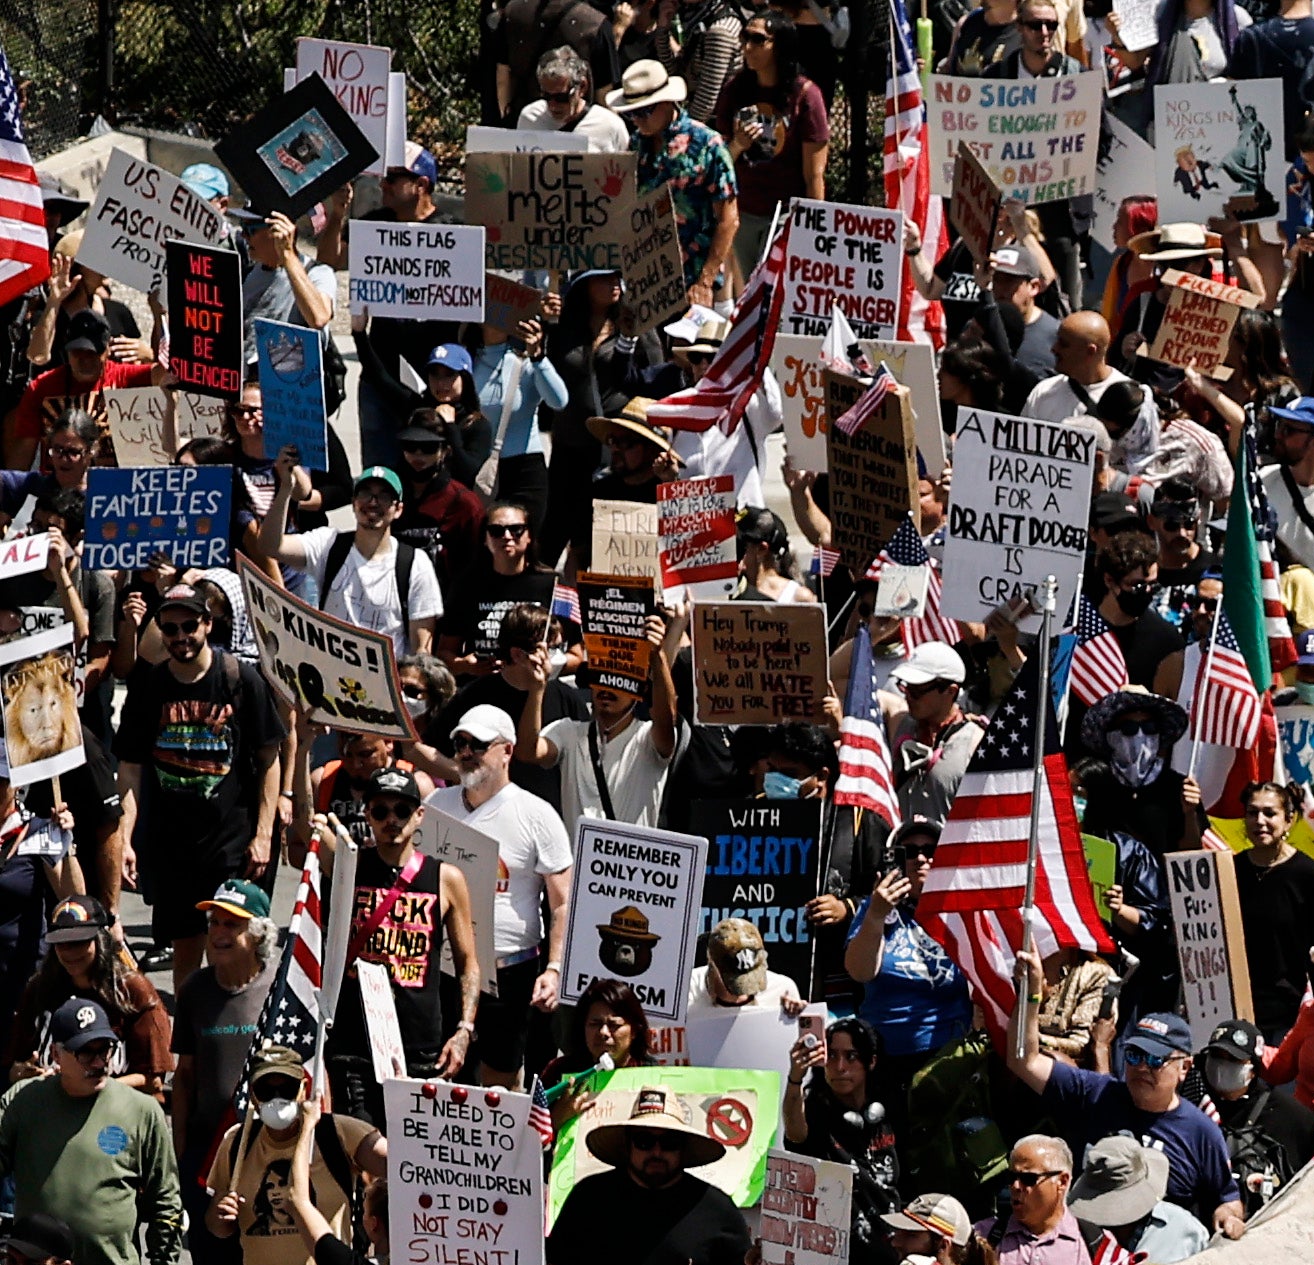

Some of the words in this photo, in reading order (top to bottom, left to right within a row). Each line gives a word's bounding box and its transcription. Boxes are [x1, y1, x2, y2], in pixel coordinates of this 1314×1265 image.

[935, 82, 971, 102] NO
[979, 84, 1037, 107] SIGN
[1051, 81, 1076, 101] IS
[941, 109, 978, 131] BIG
[989, 109, 1057, 133] ENOUGH
[1065, 110, 1086, 126] TO
[529, 157, 583, 190] ICE
[508, 189, 609, 229] melts
[524, 223, 593, 247] under
[795, 206, 826, 230] THE
[834, 209, 896, 241] POWER
[377, 230, 411, 248] THIS
[416, 231, 456, 249] FLAG
[814, 235, 838, 254] OF
[844, 239, 881, 263] THE
[190, 255, 213, 277] WE
[366, 255, 419, 277] STANDS
[426, 259, 451, 277] FOR
[790, 257, 854, 284] PEOPLE
[868, 268, 883, 289] IS
[186, 282, 222, 305] WILL
[350, 278, 405, 303] FREEDOM
[406, 287, 426, 305] NOT
[428, 285, 481, 308] FASCISM
[185, 309, 223, 331] NOT
[194, 335, 213, 358] BE
[171, 356, 239, 391] SILENCED
[133, 469, 197, 491] KEEP
[91, 492, 222, 515] FAMILIES
[599, 673, 639, 695] AHORA!
[704, 670, 730, 688] We
[735, 674, 755, 690] all
[761, 675, 814, 695] HATE
[709, 695, 735, 710] YOU
[742, 695, 769, 710] FOR
[772, 695, 814, 717] FREE
[591, 839, 681, 869] REMEMBER
[589, 859, 636, 883] ONLY
[641, 867, 679, 889] YOU
[588, 881, 617, 899] CAN
[621, 887, 677, 910] PREVENT
[410, 1092, 423, 1113] I
[433, 1100, 482, 1123] NEED
[489, 1106, 515, 1129] TO
[404, 1118, 432, 1139] BE
[437, 1124, 485, 1148] ABLE
[490, 1129, 515, 1150] TO
[424, 1143, 470, 1165] TELL
[472, 1149, 502, 1172] MY
[400, 1161, 531, 1197] GRANDCHILDREN
[438, 1193, 450, 1213] I
[457, 1195, 489, 1213] DID
[412, 1215, 449, 1237] NOT
[457, 1220, 504, 1244] STAY
